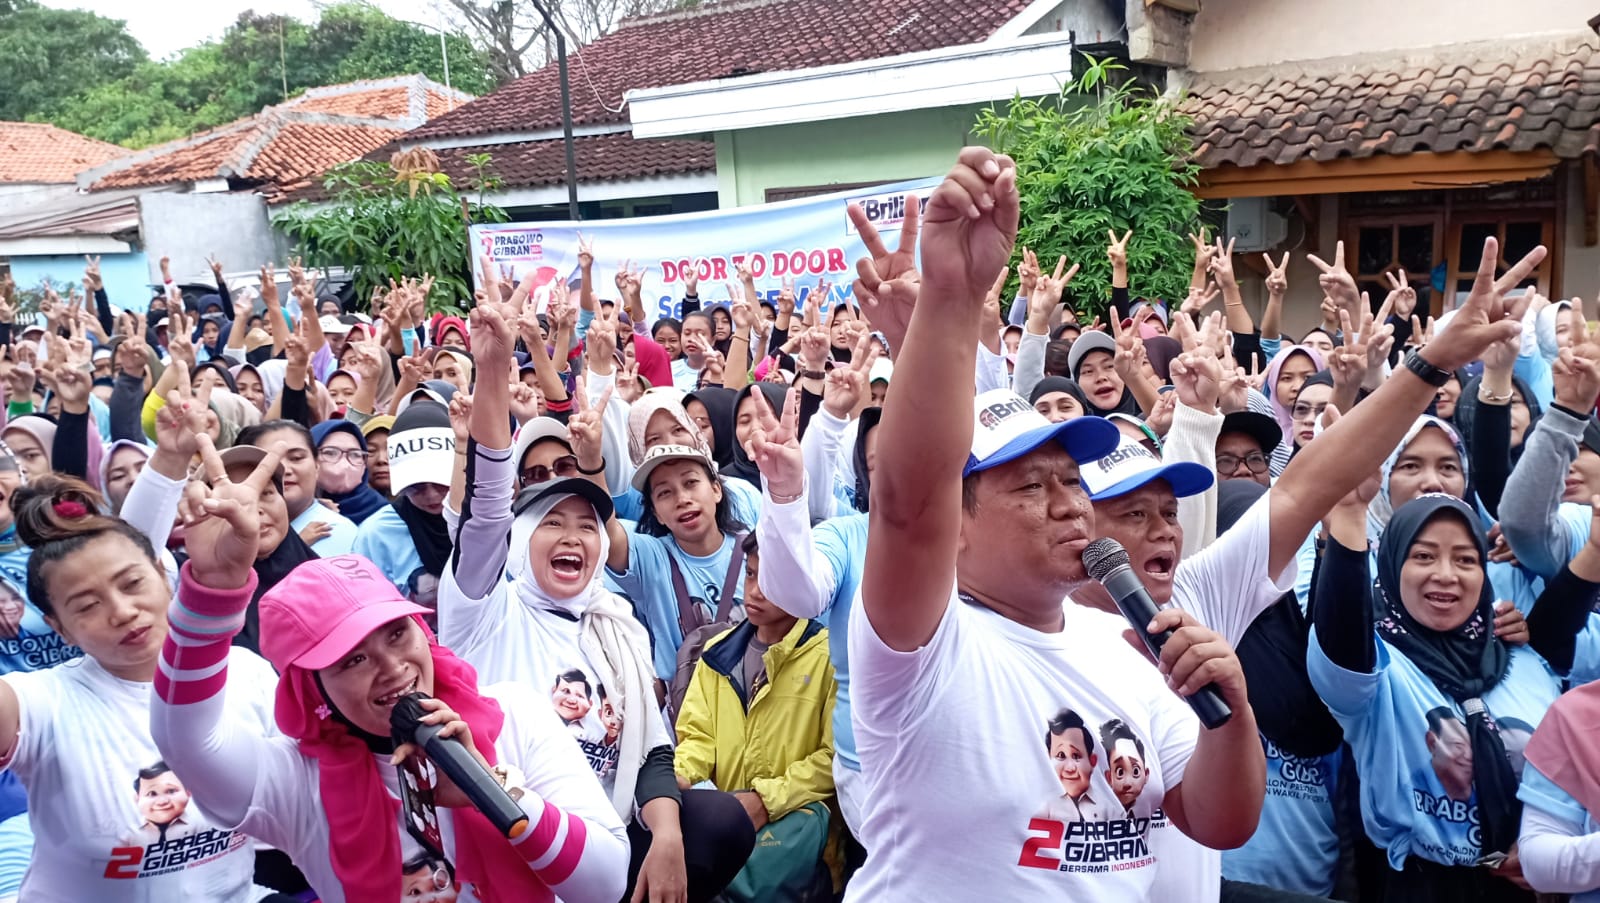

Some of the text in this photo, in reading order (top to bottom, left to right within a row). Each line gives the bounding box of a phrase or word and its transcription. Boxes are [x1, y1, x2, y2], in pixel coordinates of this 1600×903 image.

[493, 245, 530, 256] GIBRAN
[494, 233, 543, 246] PRABOWO
[661, 257, 728, 283] DOOR
[772, 248, 847, 276] DOOR
[143, 837, 231, 871] GIBRAN
[1018, 817, 1064, 871] 2
[1065, 837, 1149, 863] GIBRAN
[104, 846, 144, 879] 2
[1059, 864, 1110, 873] BERSAMA
